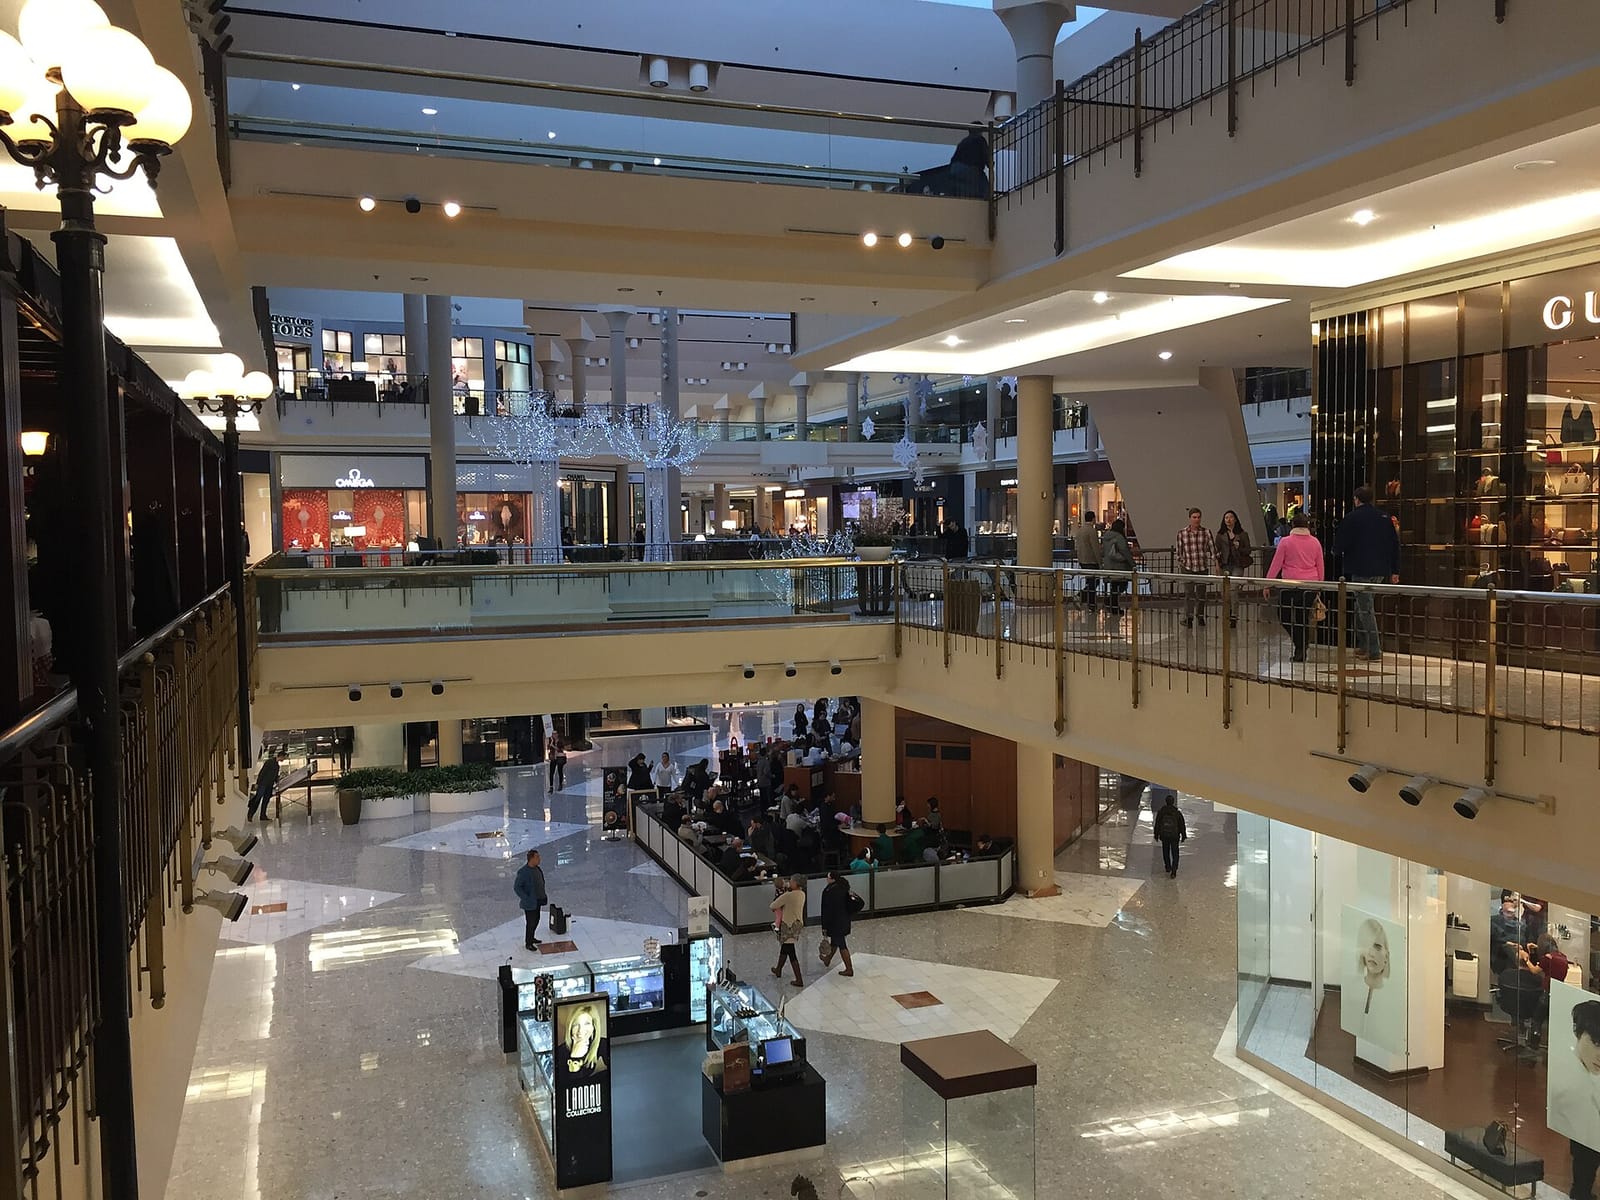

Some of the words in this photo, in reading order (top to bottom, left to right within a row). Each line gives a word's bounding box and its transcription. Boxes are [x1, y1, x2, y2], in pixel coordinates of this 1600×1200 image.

[335, 478, 375, 488] OMEGA
[565, 1083, 601, 1112] LANDAU
[565, 1106, 602, 1118] COLLECTIONS
